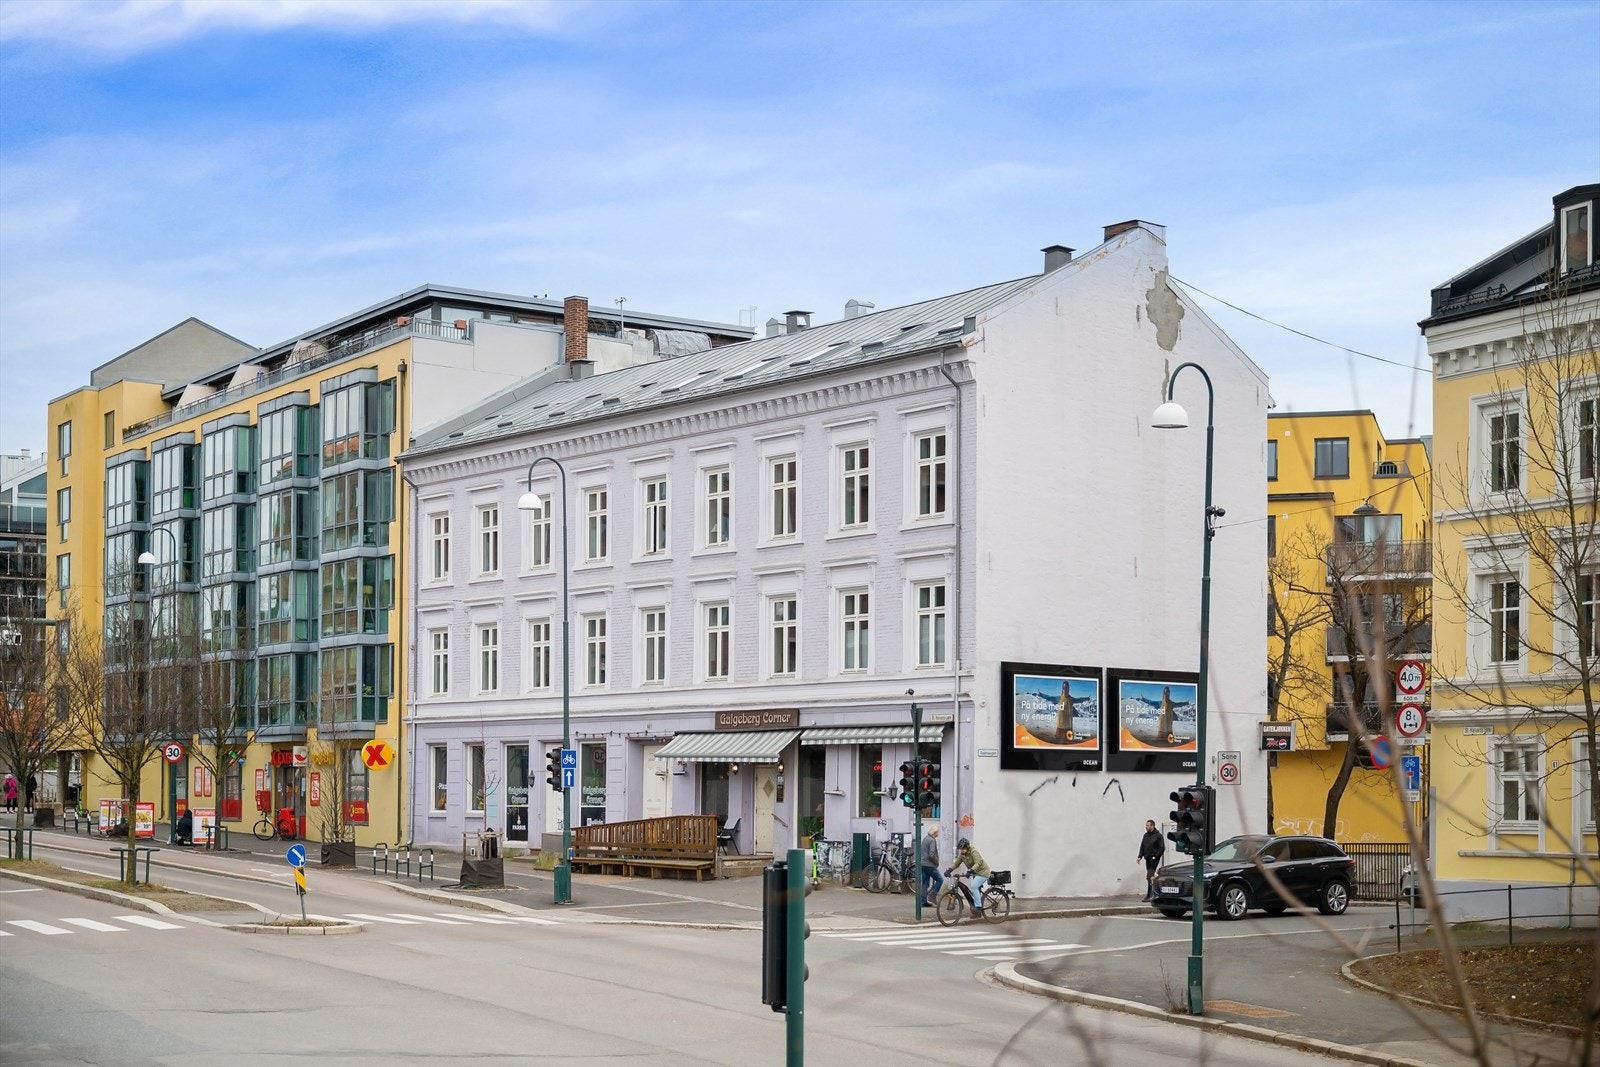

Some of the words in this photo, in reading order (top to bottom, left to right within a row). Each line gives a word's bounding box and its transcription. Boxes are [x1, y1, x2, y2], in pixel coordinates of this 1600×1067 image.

[1401, 672, 1414, 682] 4,0
[1021, 700, 1031, 709] På
[1033, 701, 1047, 710] tide
[1048, 702, 1065, 711] med
[1125, 704, 1135, 714] På
[1136, 705, 1149, 714] tide
[1150, 706, 1166, 715] med
[720, 712, 761, 727] Galgeberg
[762, 712, 791, 724] Corner
[1021, 714, 1030, 722] ny
[1031, 713, 1057, 723] energi?
[1405, 711, 1411, 720] 8
[1125, 717, 1134, 726] ny
[1135, 716, 1159, 727] energi?
[167, 747, 180, 758] 30
[1223, 767, 1235, 778] 30
